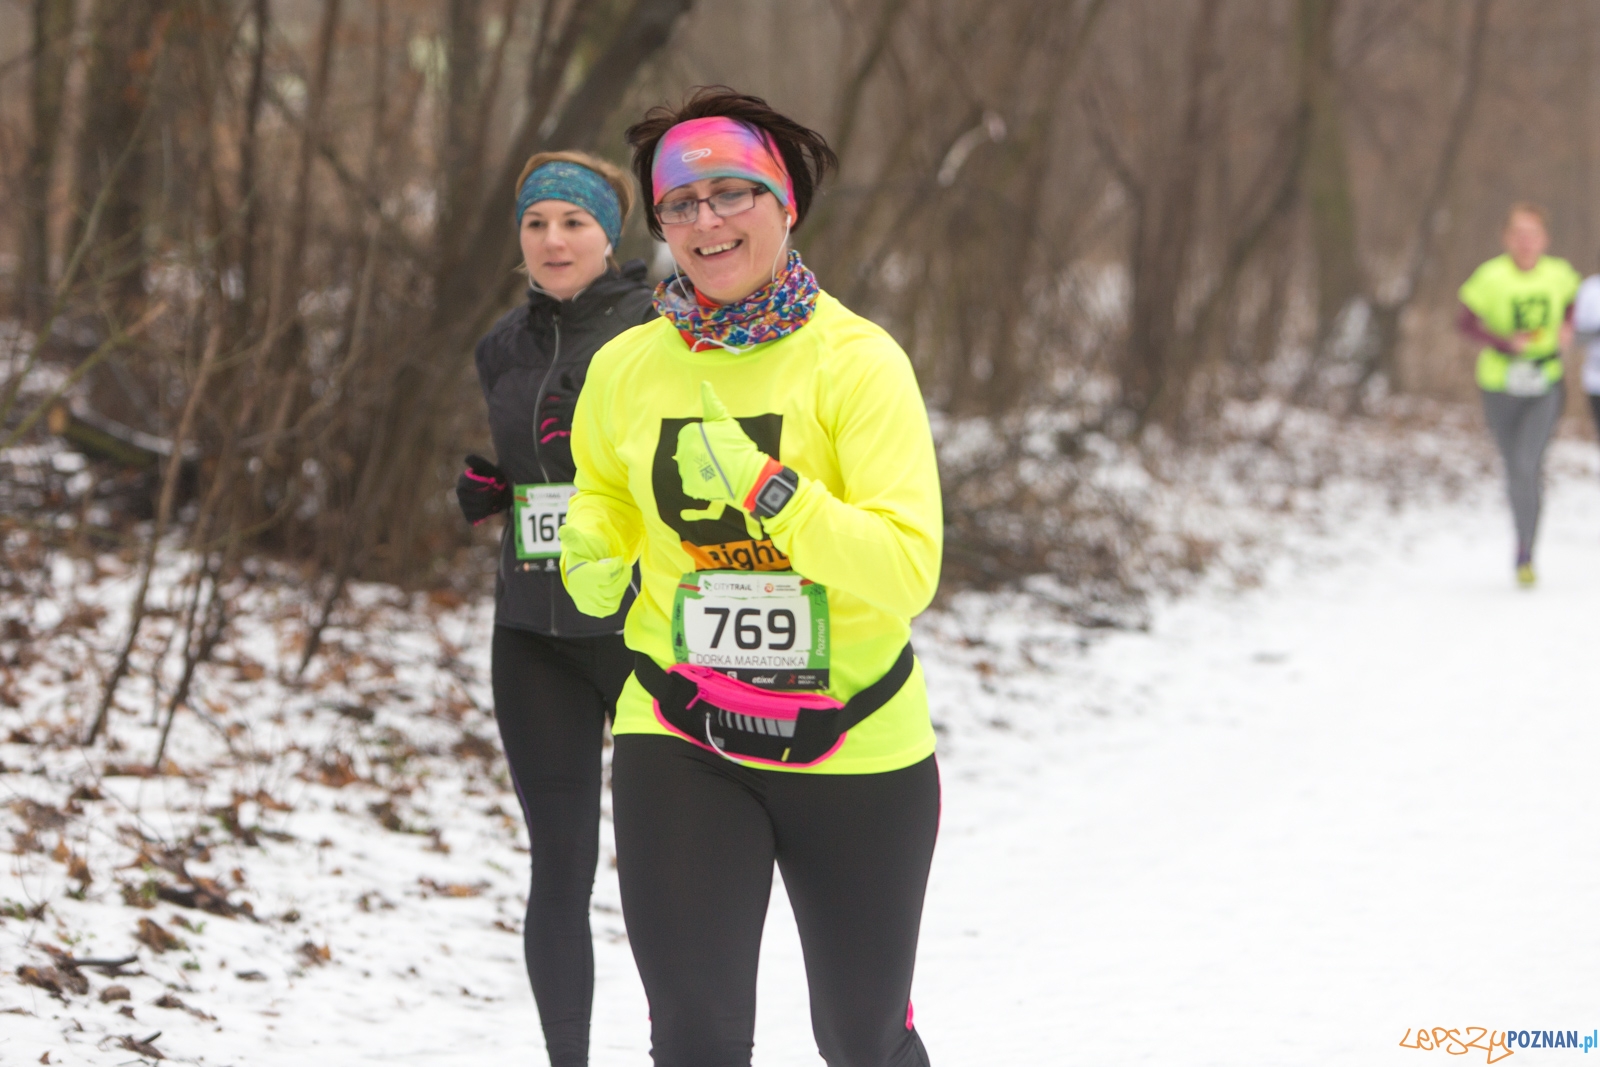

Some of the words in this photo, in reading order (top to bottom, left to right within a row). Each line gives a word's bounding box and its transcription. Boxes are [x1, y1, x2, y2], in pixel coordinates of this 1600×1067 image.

[704, 607, 796, 650] 769
[696, 653, 732, 666] DORKA
[734, 655, 806, 667] MARATONKA
